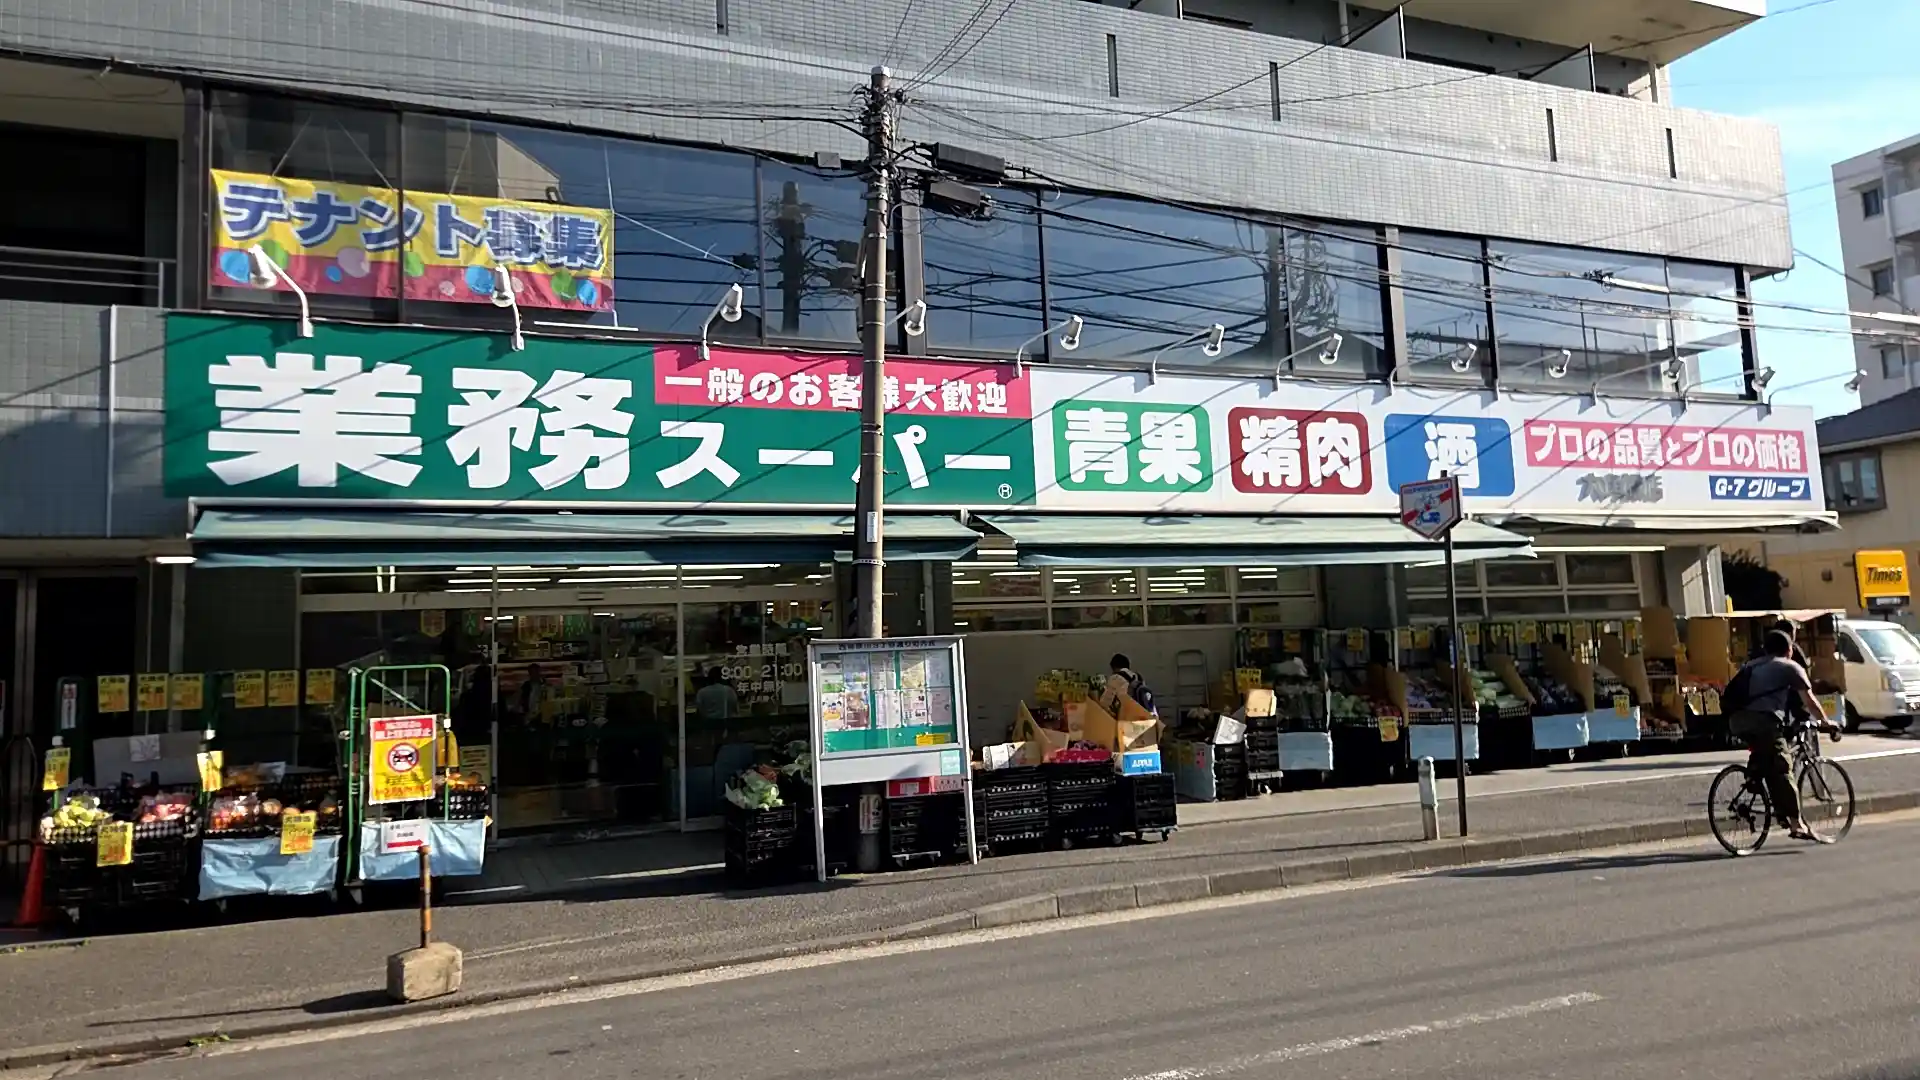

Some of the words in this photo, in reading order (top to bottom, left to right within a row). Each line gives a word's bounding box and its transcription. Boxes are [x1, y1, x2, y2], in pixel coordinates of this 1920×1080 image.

[221, 182, 606, 270] テナント募集
[1064, 406, 1203, 485] 青果
[1240, 415, 1361, 488] 精肉
[1424, 421, 1481, 489] 酒
[1529, 424, 1801, 470] プロの品質とプロの価格
[1748, 478, 1806, 498] グループ
[1866, 566, 1903, 583] Times
